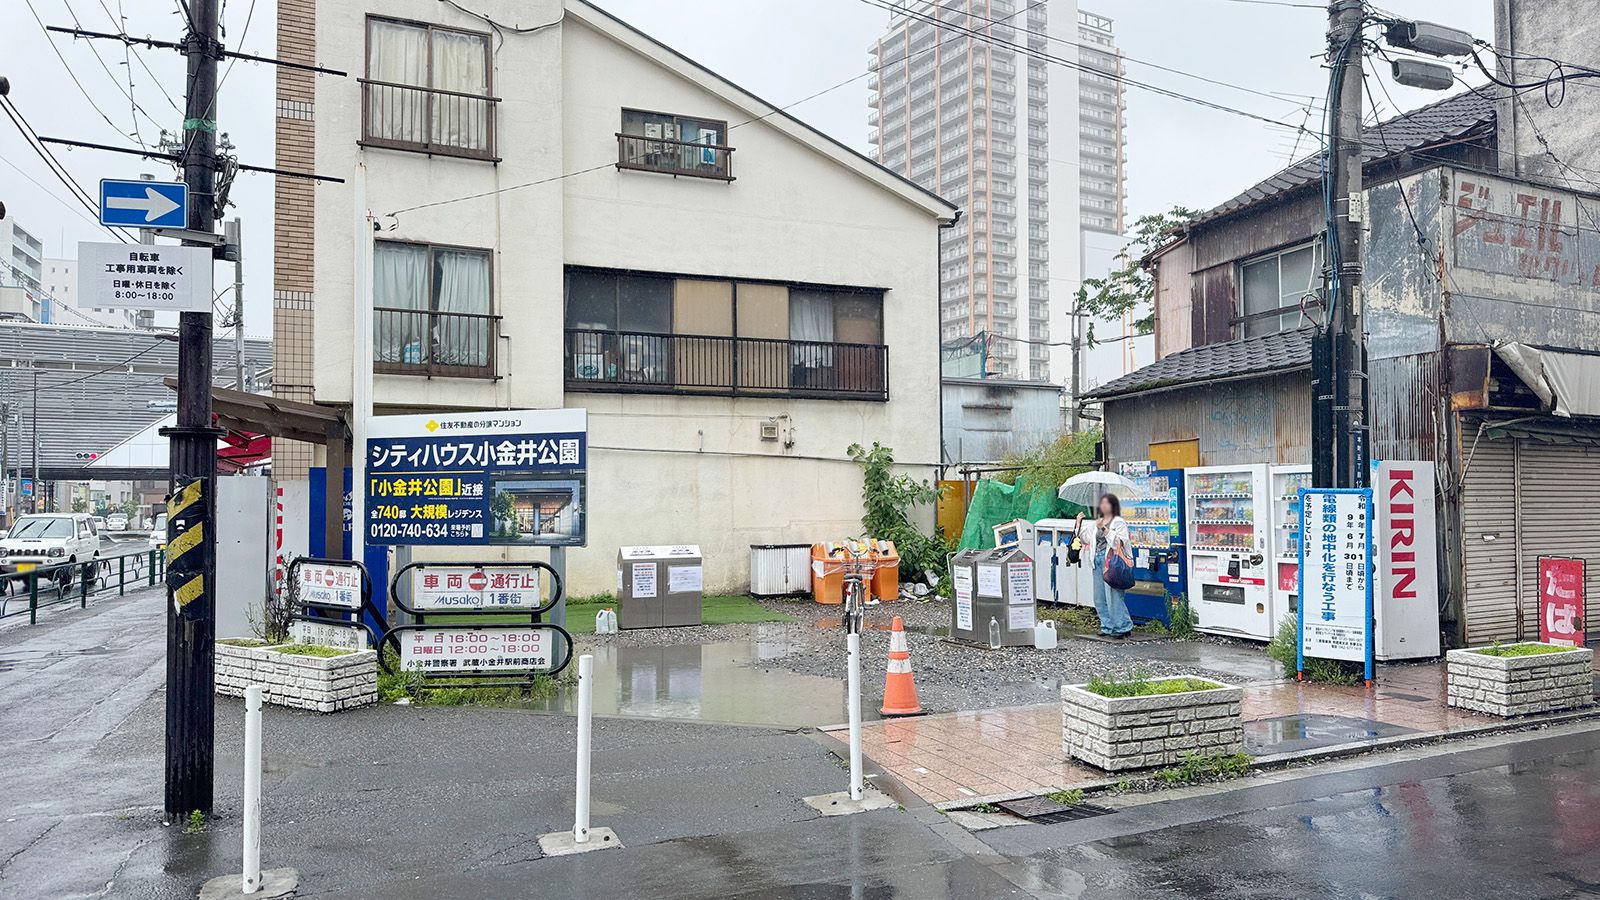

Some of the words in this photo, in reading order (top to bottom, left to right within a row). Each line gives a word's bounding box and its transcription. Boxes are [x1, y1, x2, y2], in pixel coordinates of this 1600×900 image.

[129, 252, 160, 262] 自転車
[105, 264, 184, 276] 工事用車両を除く
[113, 280, 176, 290] 日曜・休日を除く
[440, 419, 522, 430] 住友不動産の分譲マンション
[371, 438, 580, 468] シティハウス小金井公園
[371, 523, 448, 538] 0120-740-634
[1389, 469, 1417, 599] KIRIN
[1322, 494, 1337, 621] 電線類の地中化を行なう工事
[335, 571, 358, 588] 通行止
[490, 573, 535, 589] 通行止
[433, 593, 480, 605] Musako
[489, 592, 521, 605] 1番街
[413, 645, 443, 655] 日曜日
[406, 659, 457, 668] 小金井警察署
[463, 656, 546, 667] 武蔵小金井駅前商店会
